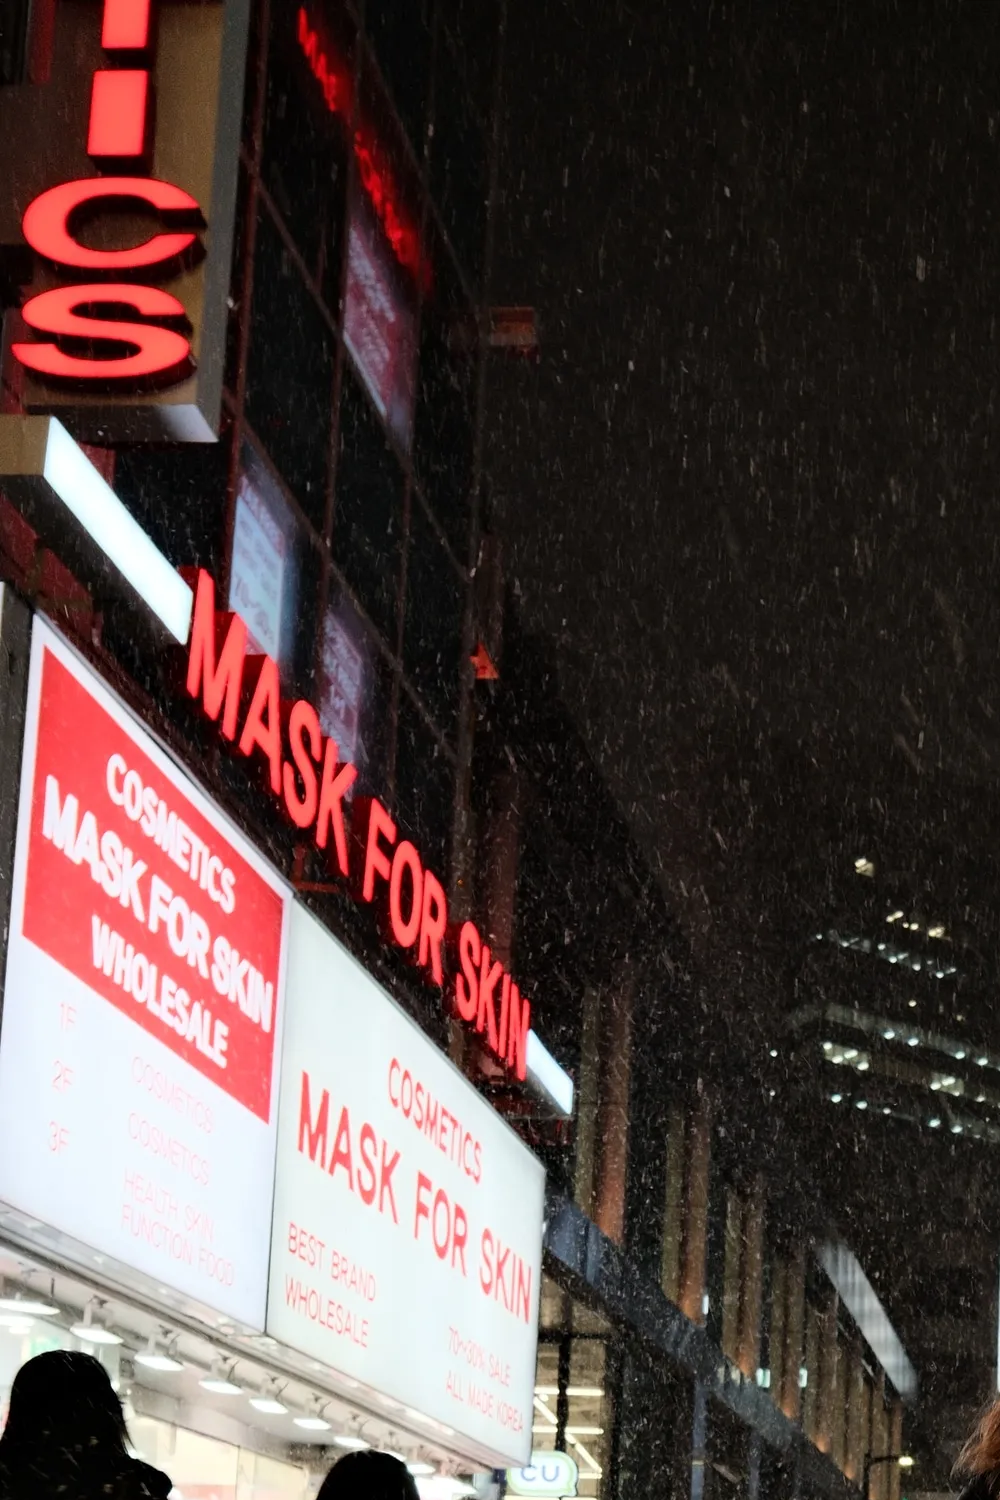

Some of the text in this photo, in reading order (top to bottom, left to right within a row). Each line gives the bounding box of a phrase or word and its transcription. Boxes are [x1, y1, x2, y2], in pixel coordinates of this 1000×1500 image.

[107, 753, 236, 915] COSMETICS
[186, 566, 358, 877] MASK
[362, 797, 447, 986] FOR
[456, 920, 531, 1081] SKIN
[43, 774, 274, 1033] MASK FOR SKIN
[91, 914, 230, 1070] WHOLESALE
[52, 1060, 209, 1186] 2F COSMETICS
[60, 1002, 214, 1134] 1F COSMETICS
[388, 1057, 482, 1184] COSMETICS
[48, 1120, 214, 1244] 3F HEALTH SKIN
[297, 1070, 534, 1325] MASK FOR SKIN
[121, 1204, 235, 1287] FUNCTION FOOD
[287, 1221, 377, 1303] BEST BRAND
[285, 1272, 370, 1350] WHOLESALE
[489, 1353, 511, 1388] SALE
[445, 1369, 524, 1433] ALL MADE KOREA
[520, 1463, 560, 1483] CU
